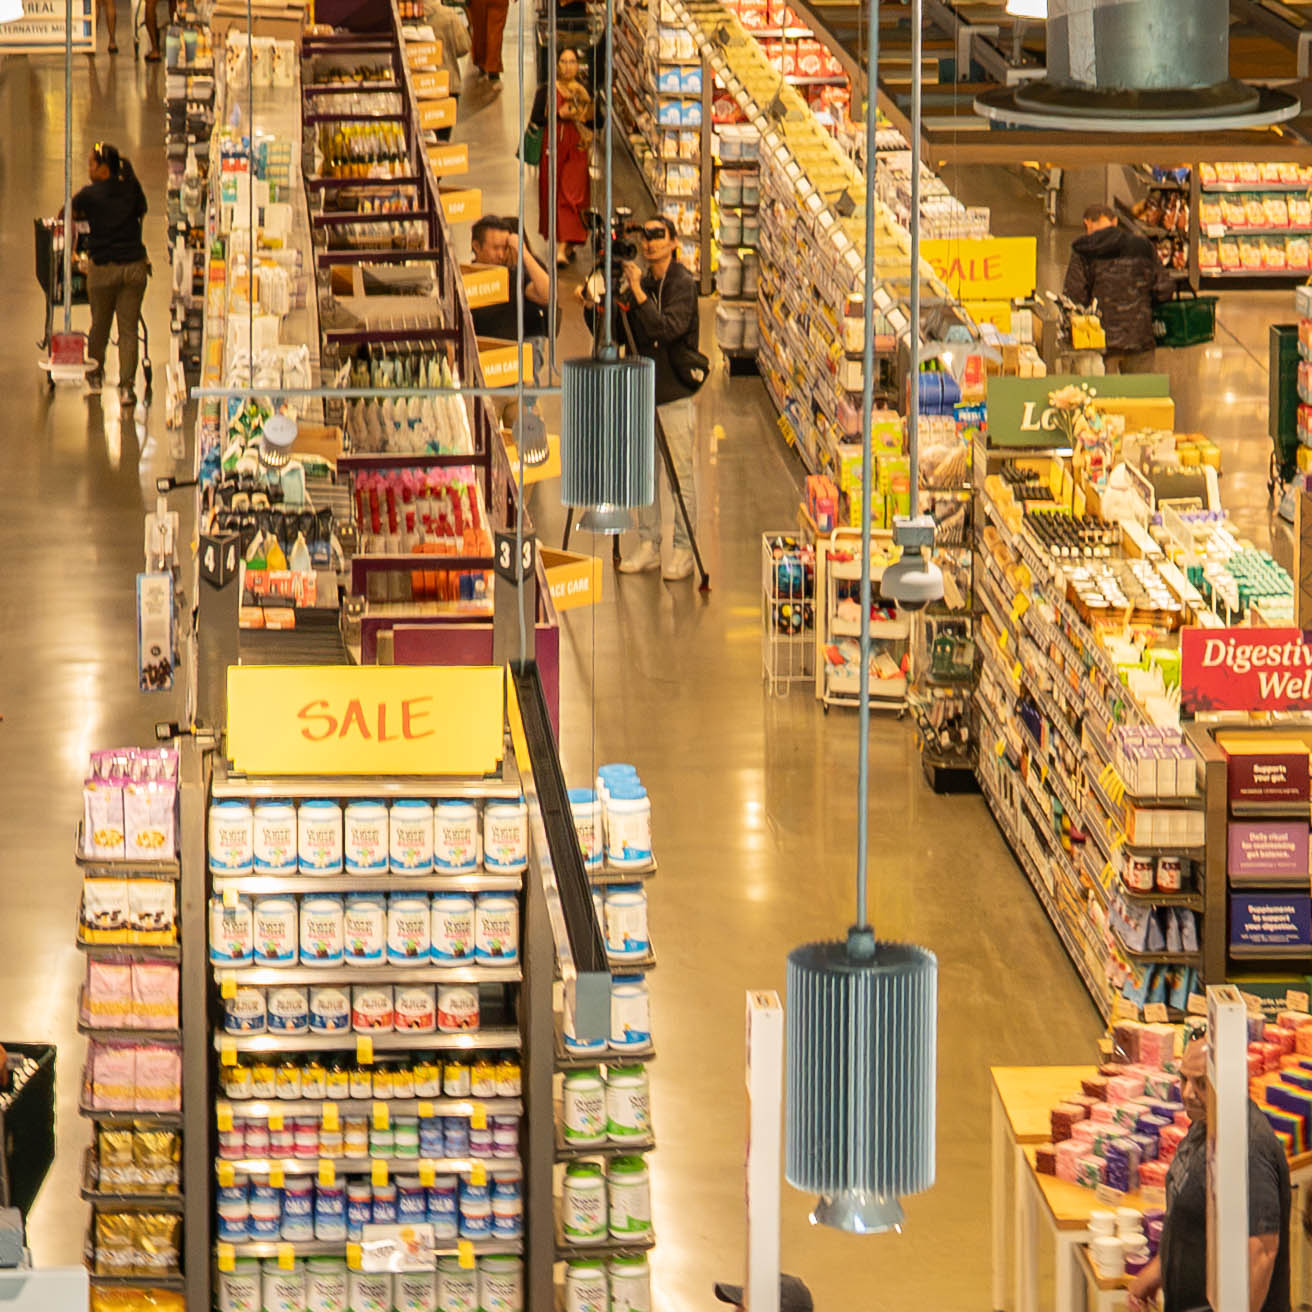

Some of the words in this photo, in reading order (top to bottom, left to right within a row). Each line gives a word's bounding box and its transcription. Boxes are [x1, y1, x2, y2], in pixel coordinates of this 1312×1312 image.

[929, 254, 1003, 281] SALE
[504, 359, 519, 373] CAR
[204, 545, 216, 572] 4
[226, 544, 236, 571] 4
[500, 541, 511, 569] 3
[522, 539, 532, 569] 3
[550, 581, 565, 598] ACE
[297, 695, 436, 743] SALE
